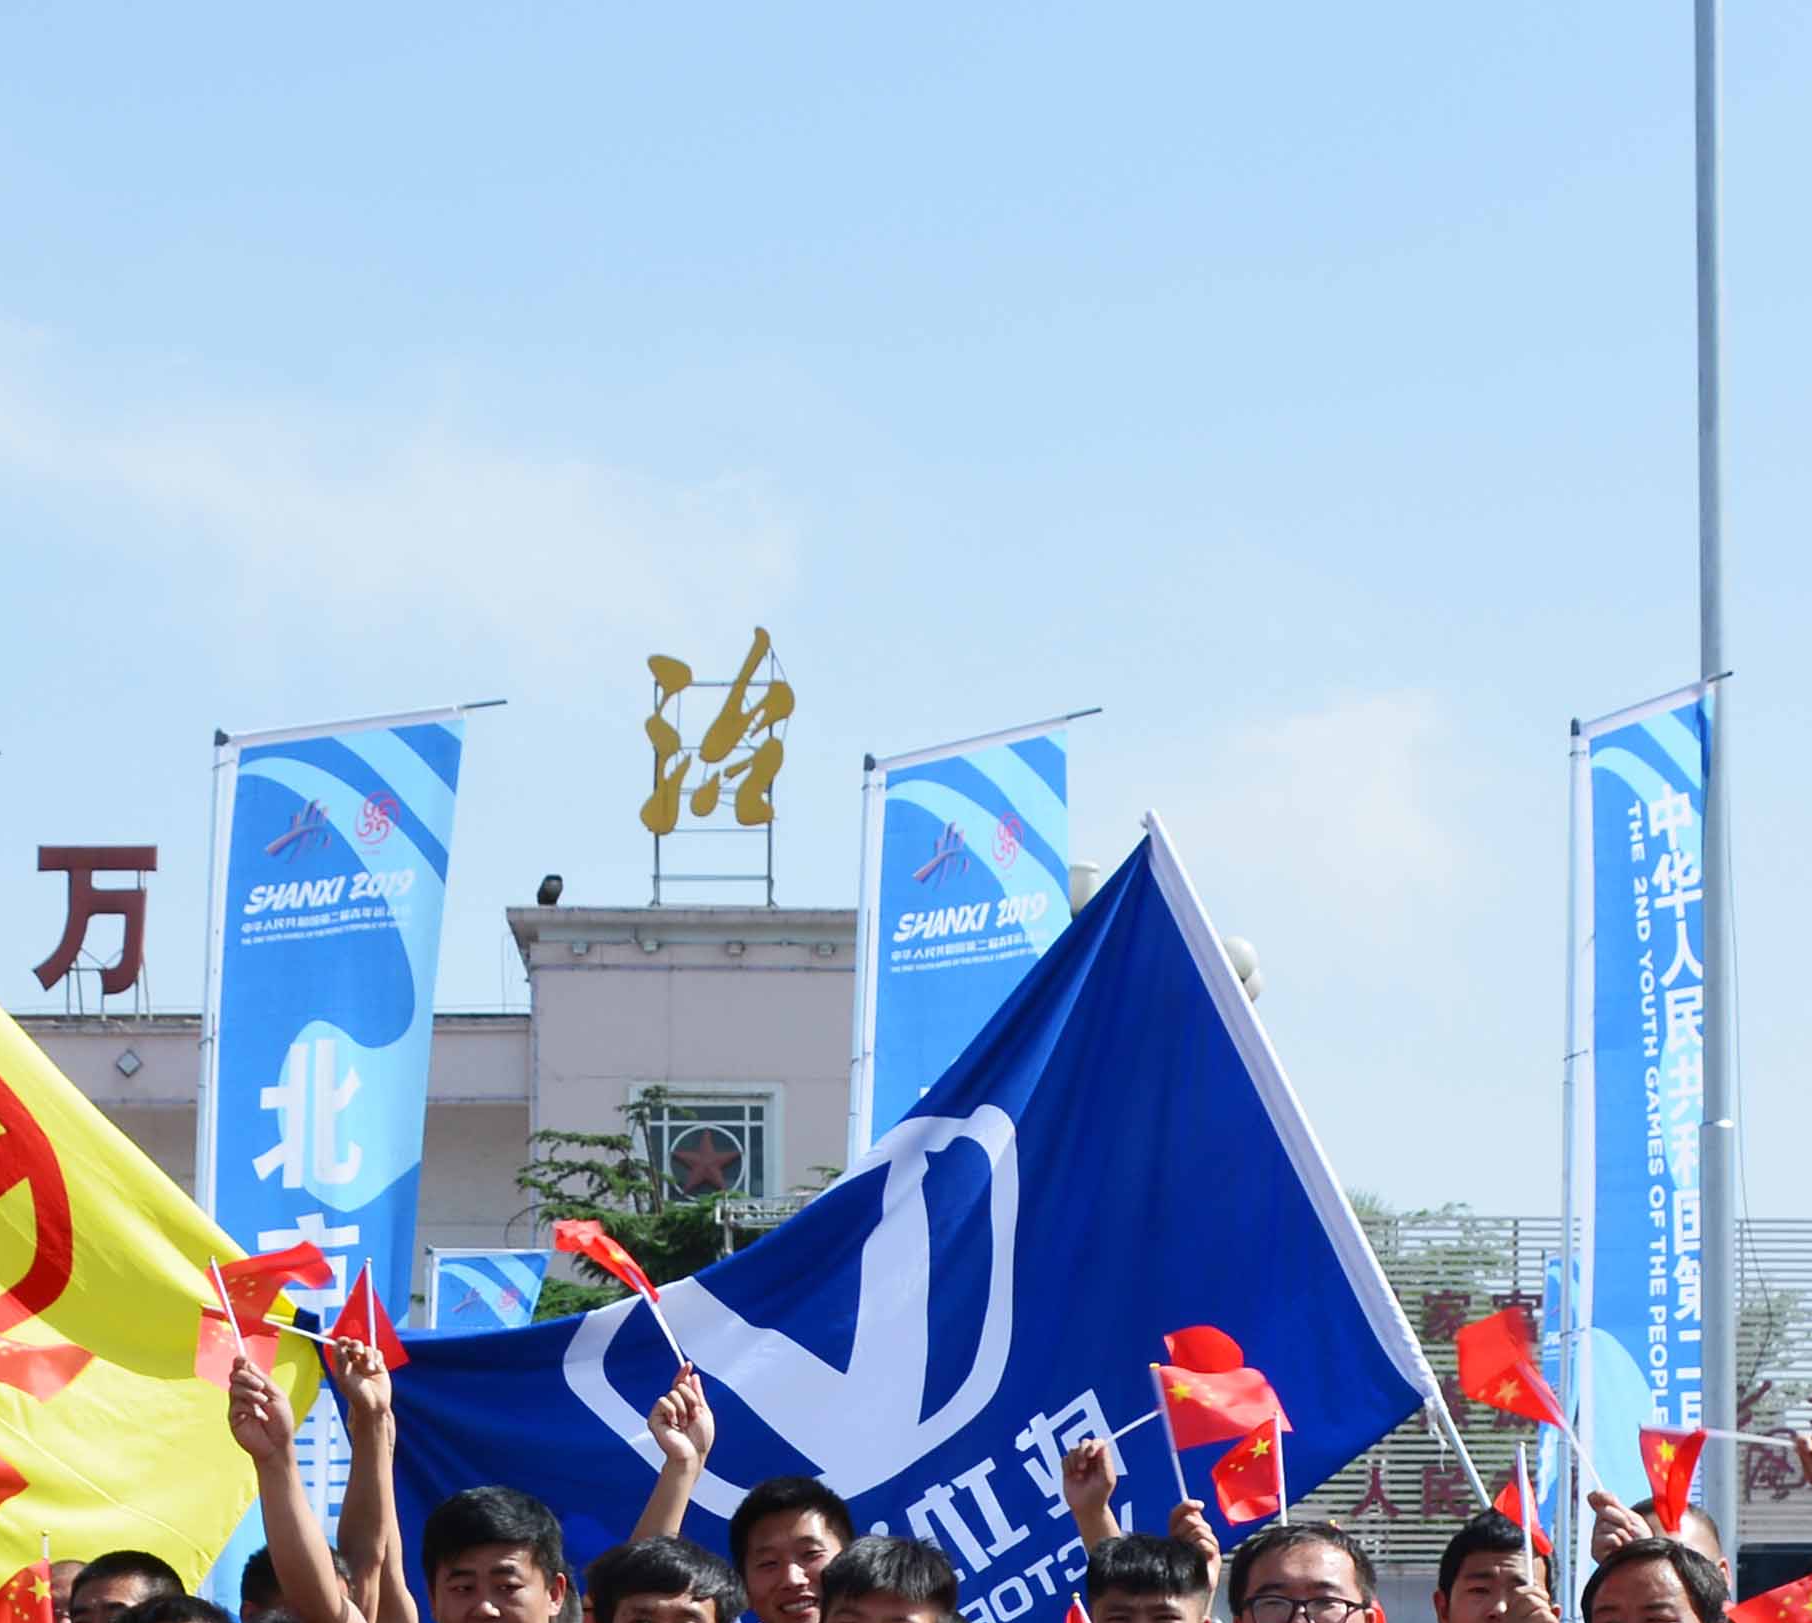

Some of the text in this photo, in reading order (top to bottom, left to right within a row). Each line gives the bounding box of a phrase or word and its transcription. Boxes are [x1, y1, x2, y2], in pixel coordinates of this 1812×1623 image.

[1628, 799, 1646, 863] THE
[244, 868, 416, 915] SHANXI 2019
[892, 892, 1049, 943] SHANXI 2019
[1634, 876, 1651, 942] 2ND
[1639, 949, 1660, 1059] YOUTH
[1644, 1065, 1665, 1177] GAMES
[1647, 783, 1703, 1428] 中华人民共和国第二
[1648, 1185, 1666, 1229] OF
[1648, 1235, 1667, 1297] THE
